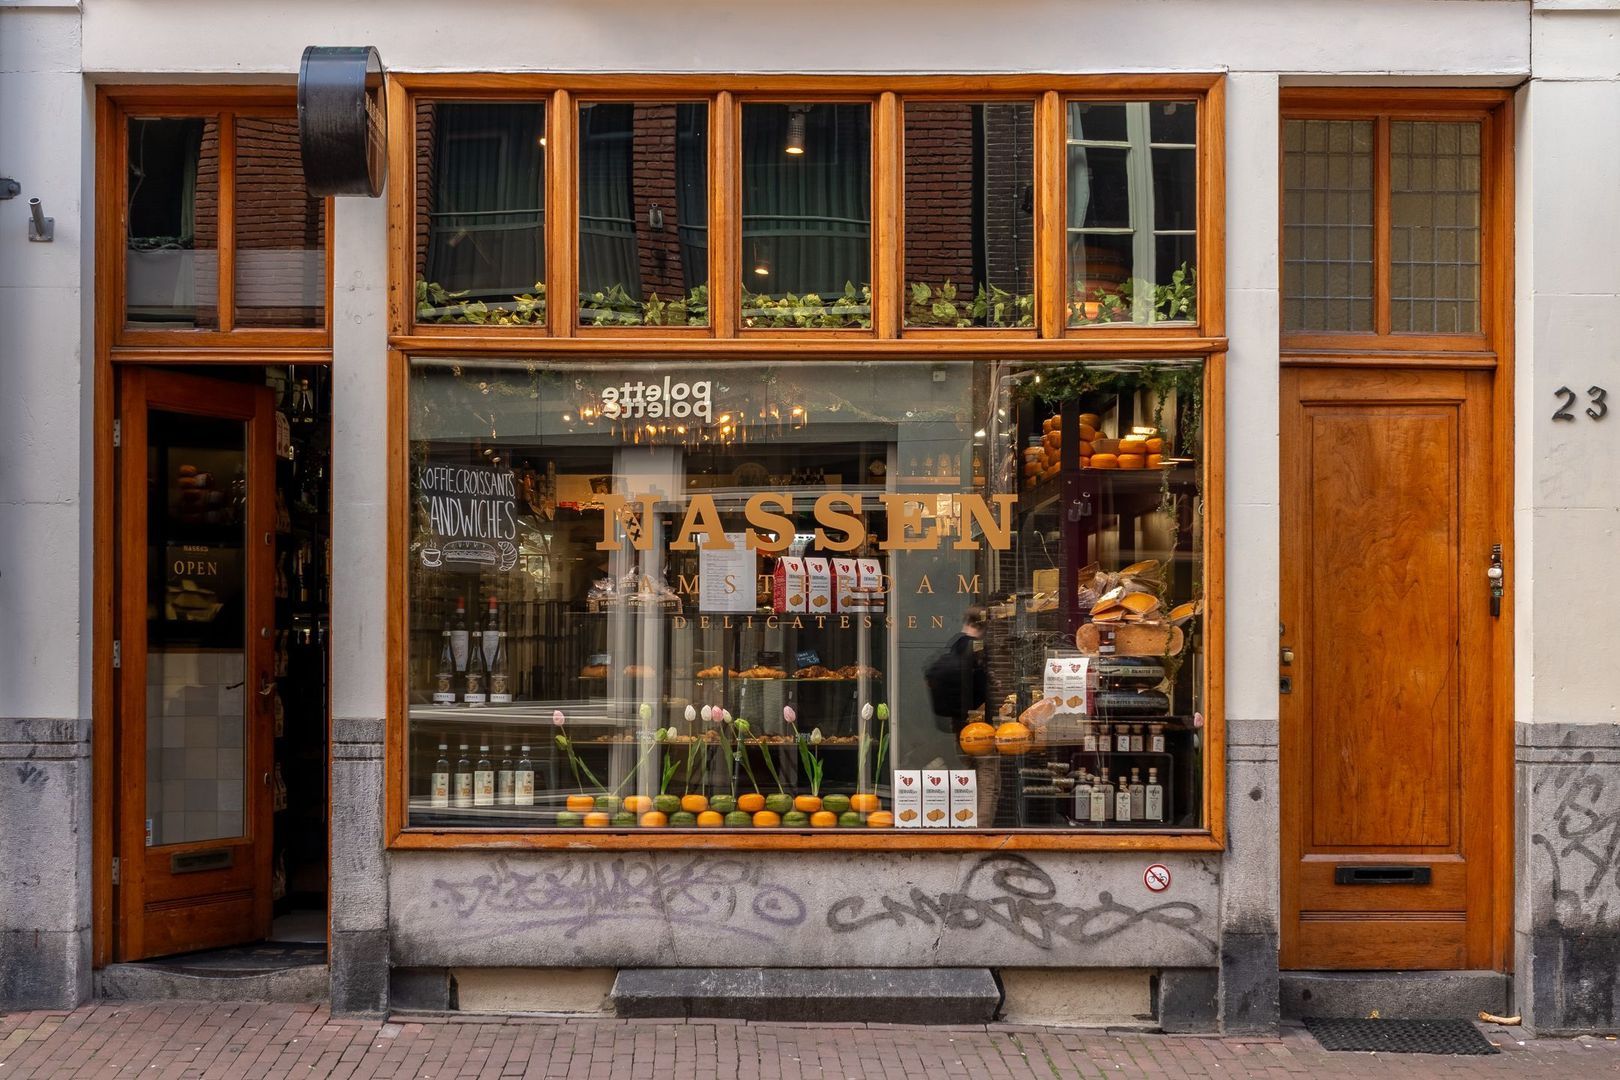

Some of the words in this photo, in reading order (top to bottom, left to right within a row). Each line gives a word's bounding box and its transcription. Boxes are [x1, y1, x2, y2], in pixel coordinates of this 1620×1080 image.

[1551, 386, 1608, 422] 23
[596, 493, 1018, 551] NASSEN
[174, 560, 217, 575] OPEN
[639, 574, 980, 595] AMSTERDAM
[674, 615, 944, 629] DELICATESSEN
